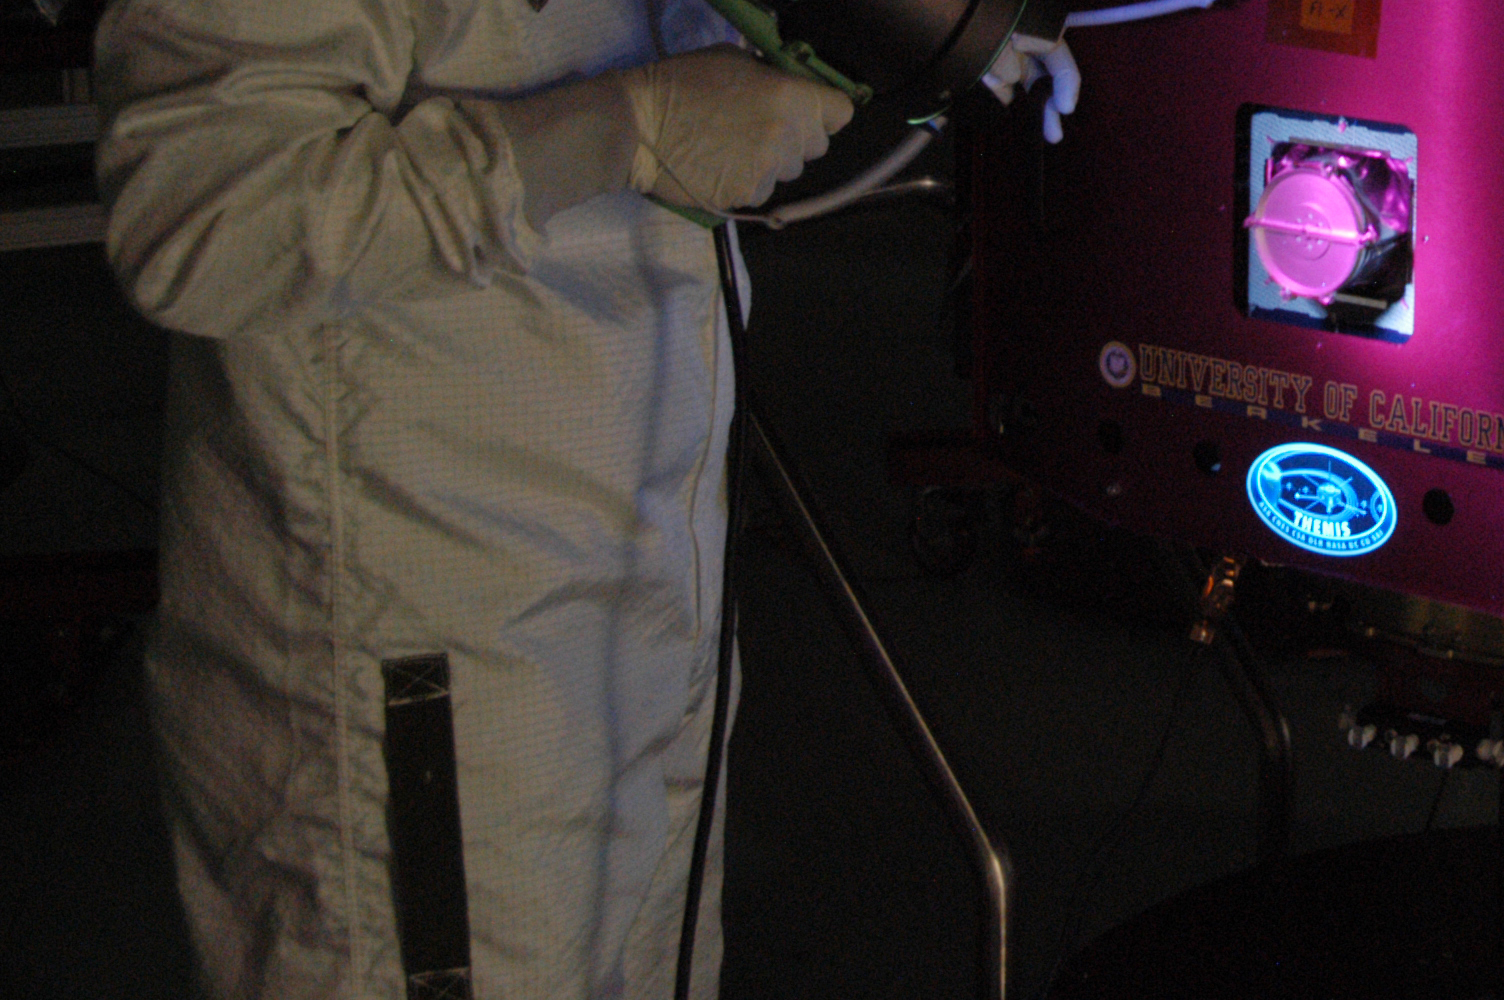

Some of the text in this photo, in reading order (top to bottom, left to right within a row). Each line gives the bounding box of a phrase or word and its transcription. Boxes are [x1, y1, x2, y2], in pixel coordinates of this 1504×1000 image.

[1139, 343, 1312, 413] UNIVERSITY
[1323, 381, 1358, 422] OF
[1294, 510, 1351, 537] THEMIS
